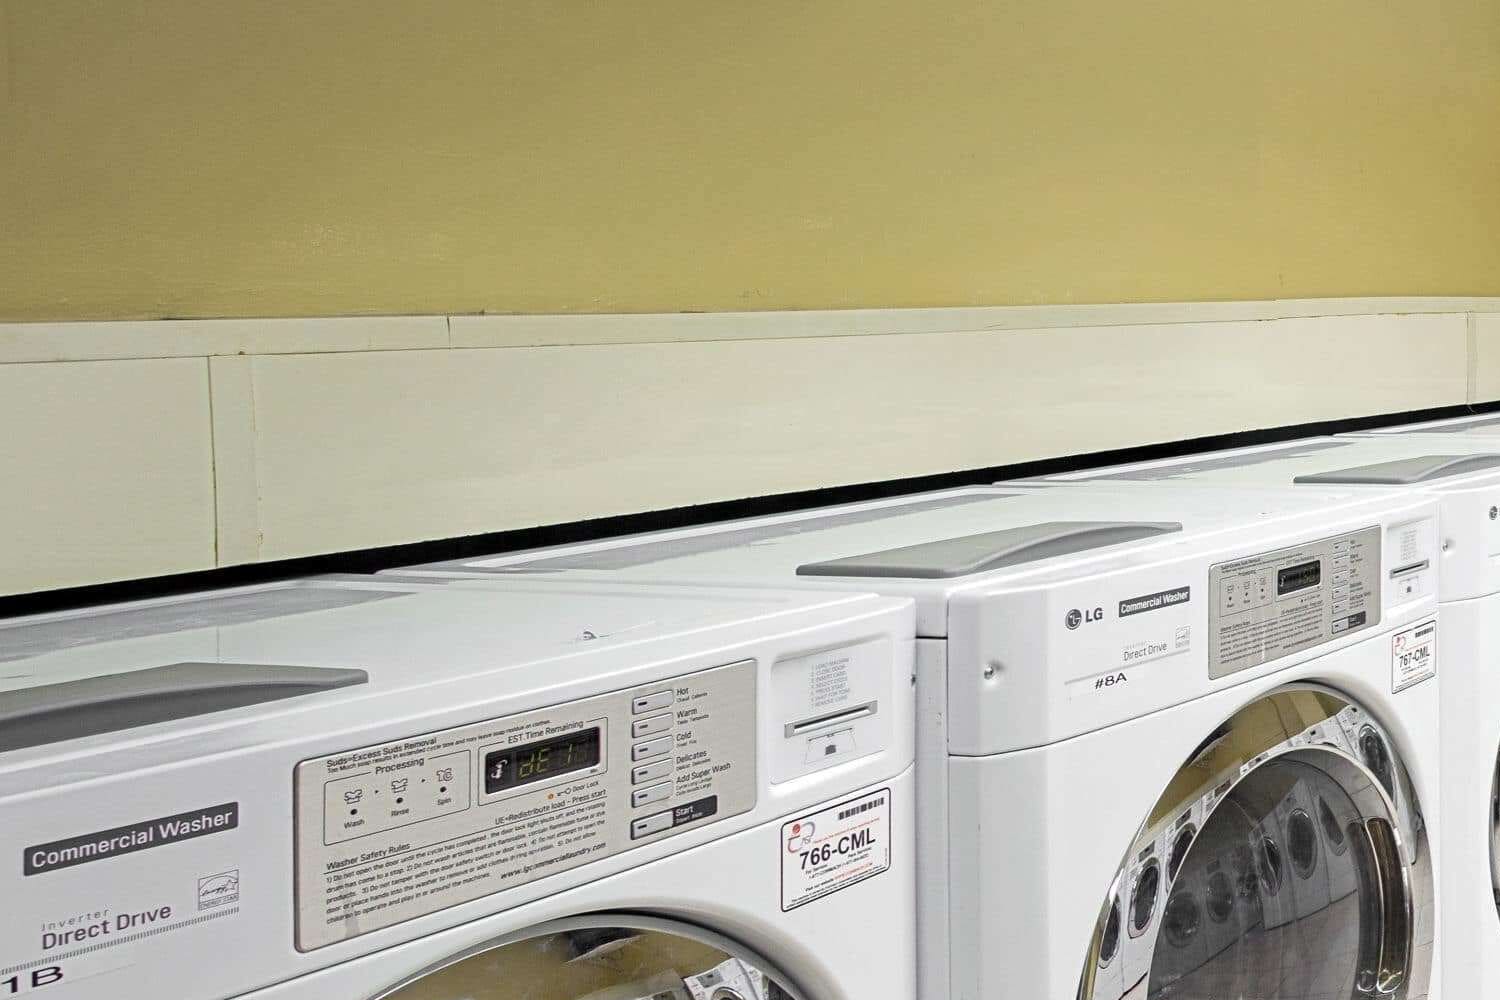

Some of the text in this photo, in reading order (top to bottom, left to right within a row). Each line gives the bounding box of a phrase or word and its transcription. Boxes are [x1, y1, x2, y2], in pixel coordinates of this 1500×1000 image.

[1121, 591, 1188, 614] Commercial Washer
[1085, 607, 1103, 623] LG
[1124, 642, 1168, 662] Direct Drive
[1399, 646, 1430, 668] 767-CML
[1095, 672, 1127, 690] #8A
[676, 687, 688, 695] Hot
[677, 708, 697, 718] Warm
[526, 730, 543, 739] Time
[545, 720, 583, 734] Remaining
[676, 730, 691, 741] Cold
[382, 745, 401, 755] Suds
[404, 737, 436, 749] Removal
[375, 757, 424, 773] Processing
[676, 750, 706, 763] Delicates
[676, 773, 689, 783] Add
[691, 768, 710, 780] Super
[712, 762, 730, 773] Wash
[572, 780, 598, 792] Door Lock
[437, 797, 451, 805] Spin
[551, 799, 565, 809] load
[572, 794, 589, 803] Press
[591, 788, 605, 798] start
[391, 808, 409, 816] Rinse
[675, 805, 693, 816] Start
[344, 819, 364, 828] Wash
[32, 810, 233, 868] Commercial Washer
[326, 843, 410, 869] Washer Safety Rules
[799, 828, 876, 870] 766-CML
[42, 905, 172, 950] Direct Drive
